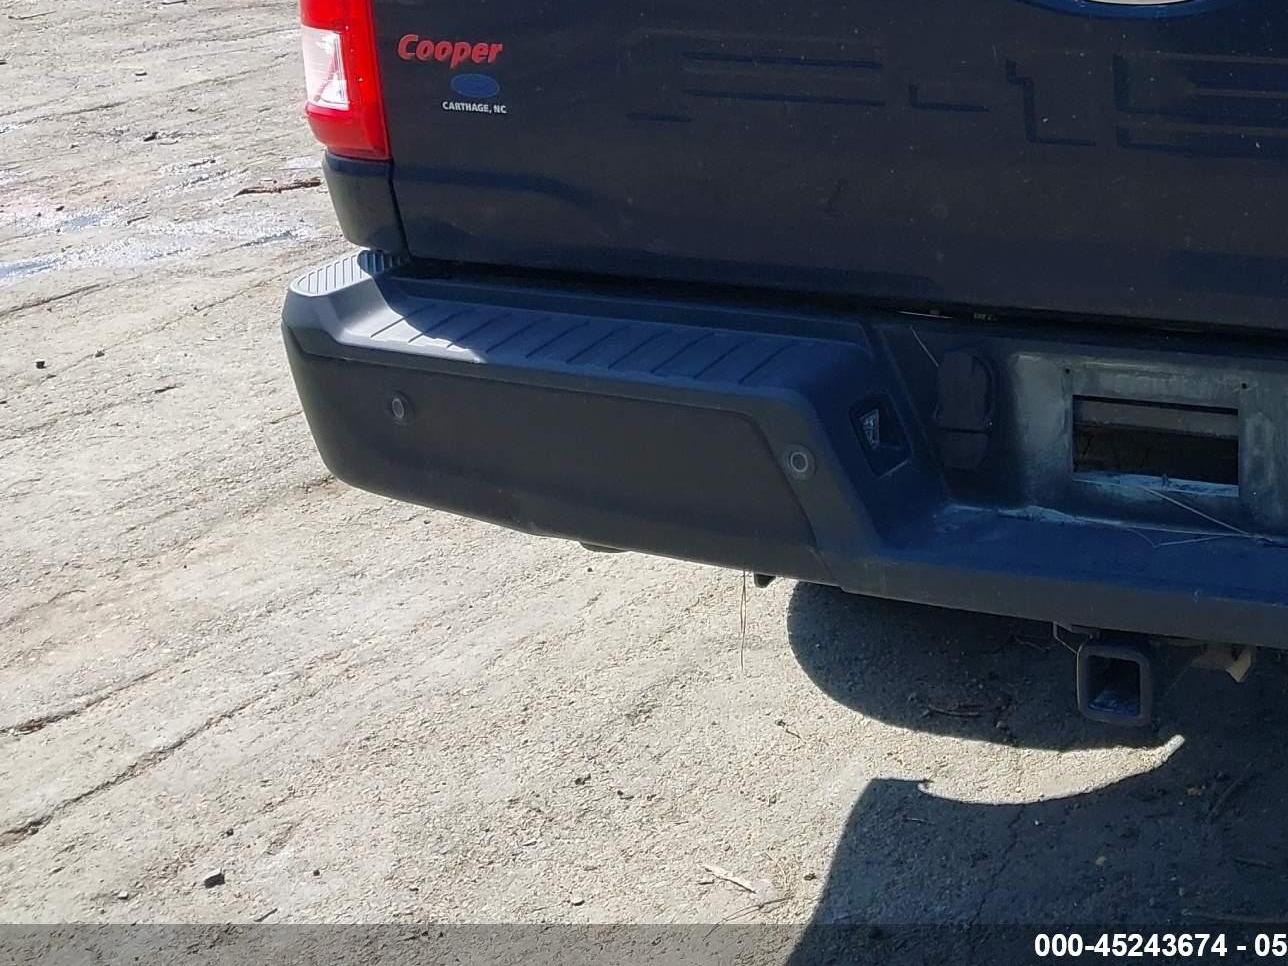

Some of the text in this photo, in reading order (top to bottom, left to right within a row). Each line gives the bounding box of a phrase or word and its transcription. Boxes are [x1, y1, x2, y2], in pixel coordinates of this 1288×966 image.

[397, 33, 504, 69] Cooper
[442, 101, 508, 114] CARTHAGE, NC
